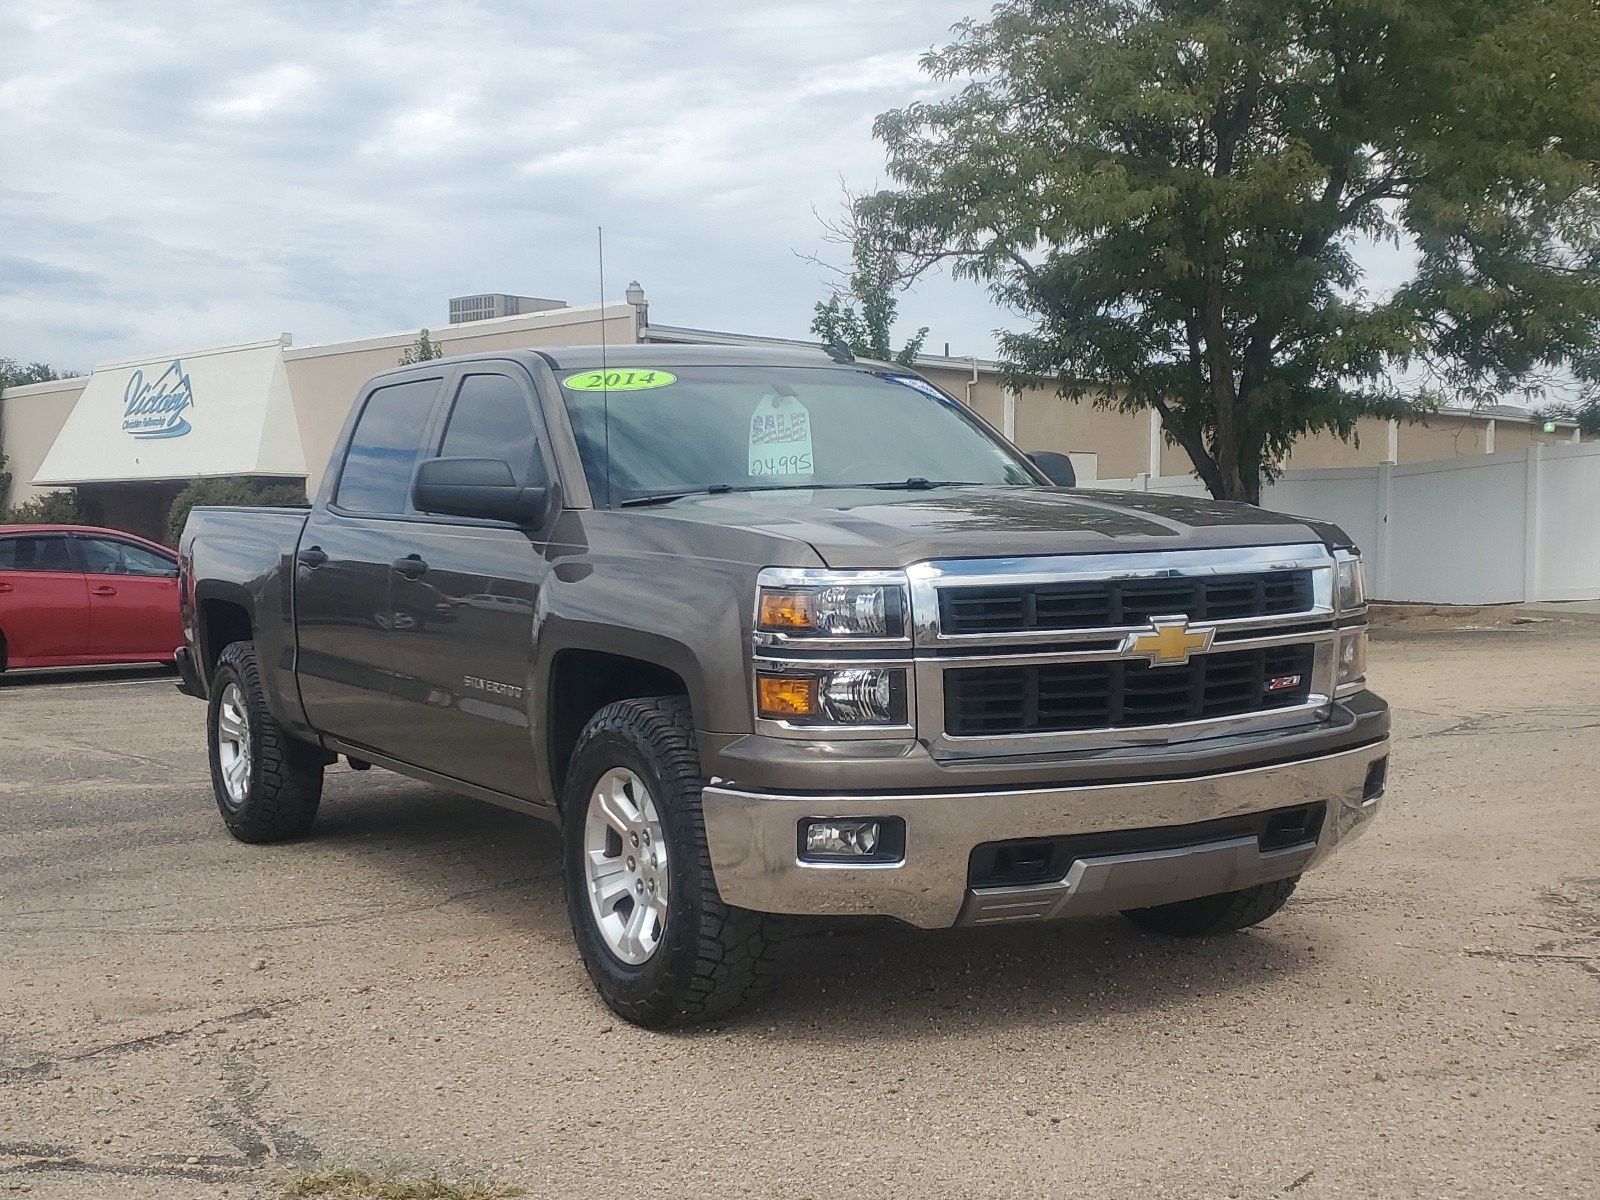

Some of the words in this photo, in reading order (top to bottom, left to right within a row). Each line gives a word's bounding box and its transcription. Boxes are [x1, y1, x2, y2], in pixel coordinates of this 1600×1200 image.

[586, 372, 656, 388] 2014
[123, 369, 190, 427] Victory
[752, 412, 808, 446] SALE
[464, 675, 522, 699] SILVERADO
[1269, 674, 1301, 690] Z71
